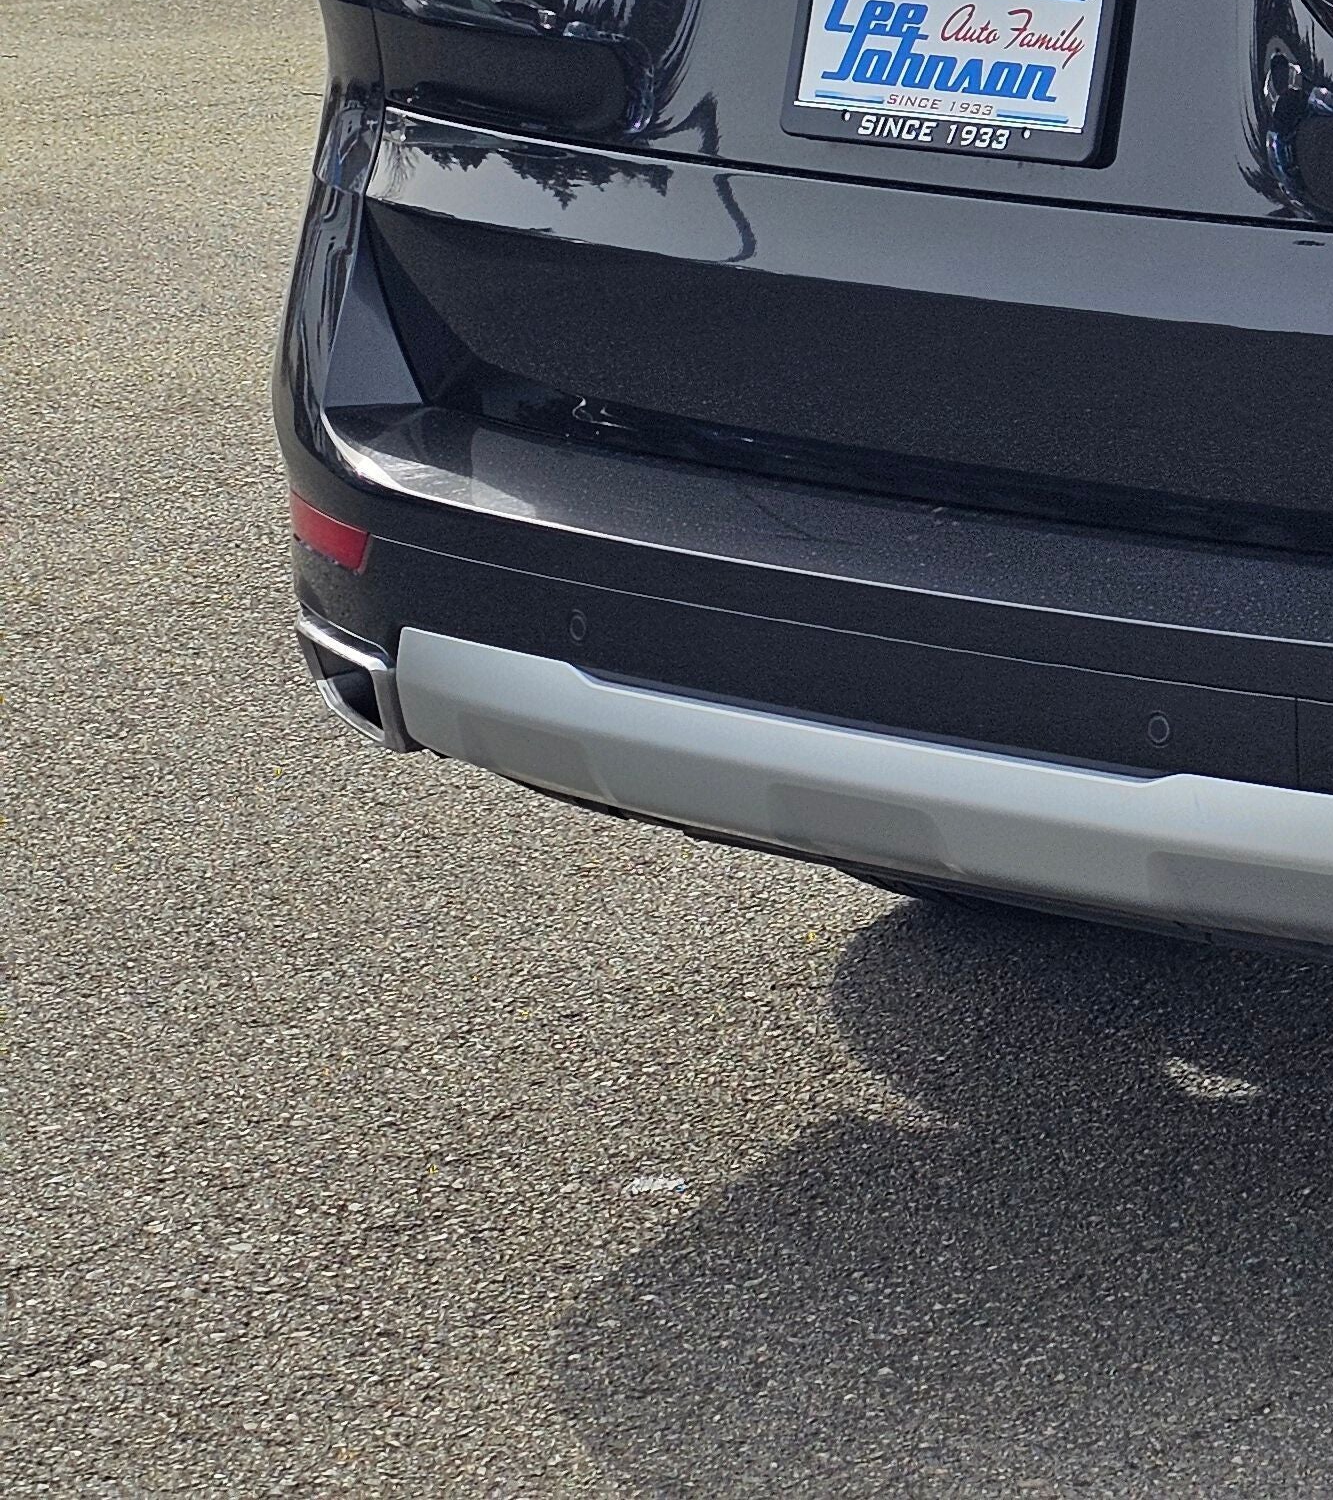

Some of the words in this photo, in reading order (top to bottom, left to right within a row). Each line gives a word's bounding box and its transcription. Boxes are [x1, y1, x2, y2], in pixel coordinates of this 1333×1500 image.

[940, 3, 1001, 44] Auto
[1003, 8, 1087, 70] Family
[821, 30, 1057, 102] Johnson
[886, 92, 943, 111] SINCE
[948, 100, 994, 117] 1933
[857, 113, 938, 143] SINCE
[946, 124, 1013, 151] 1933
